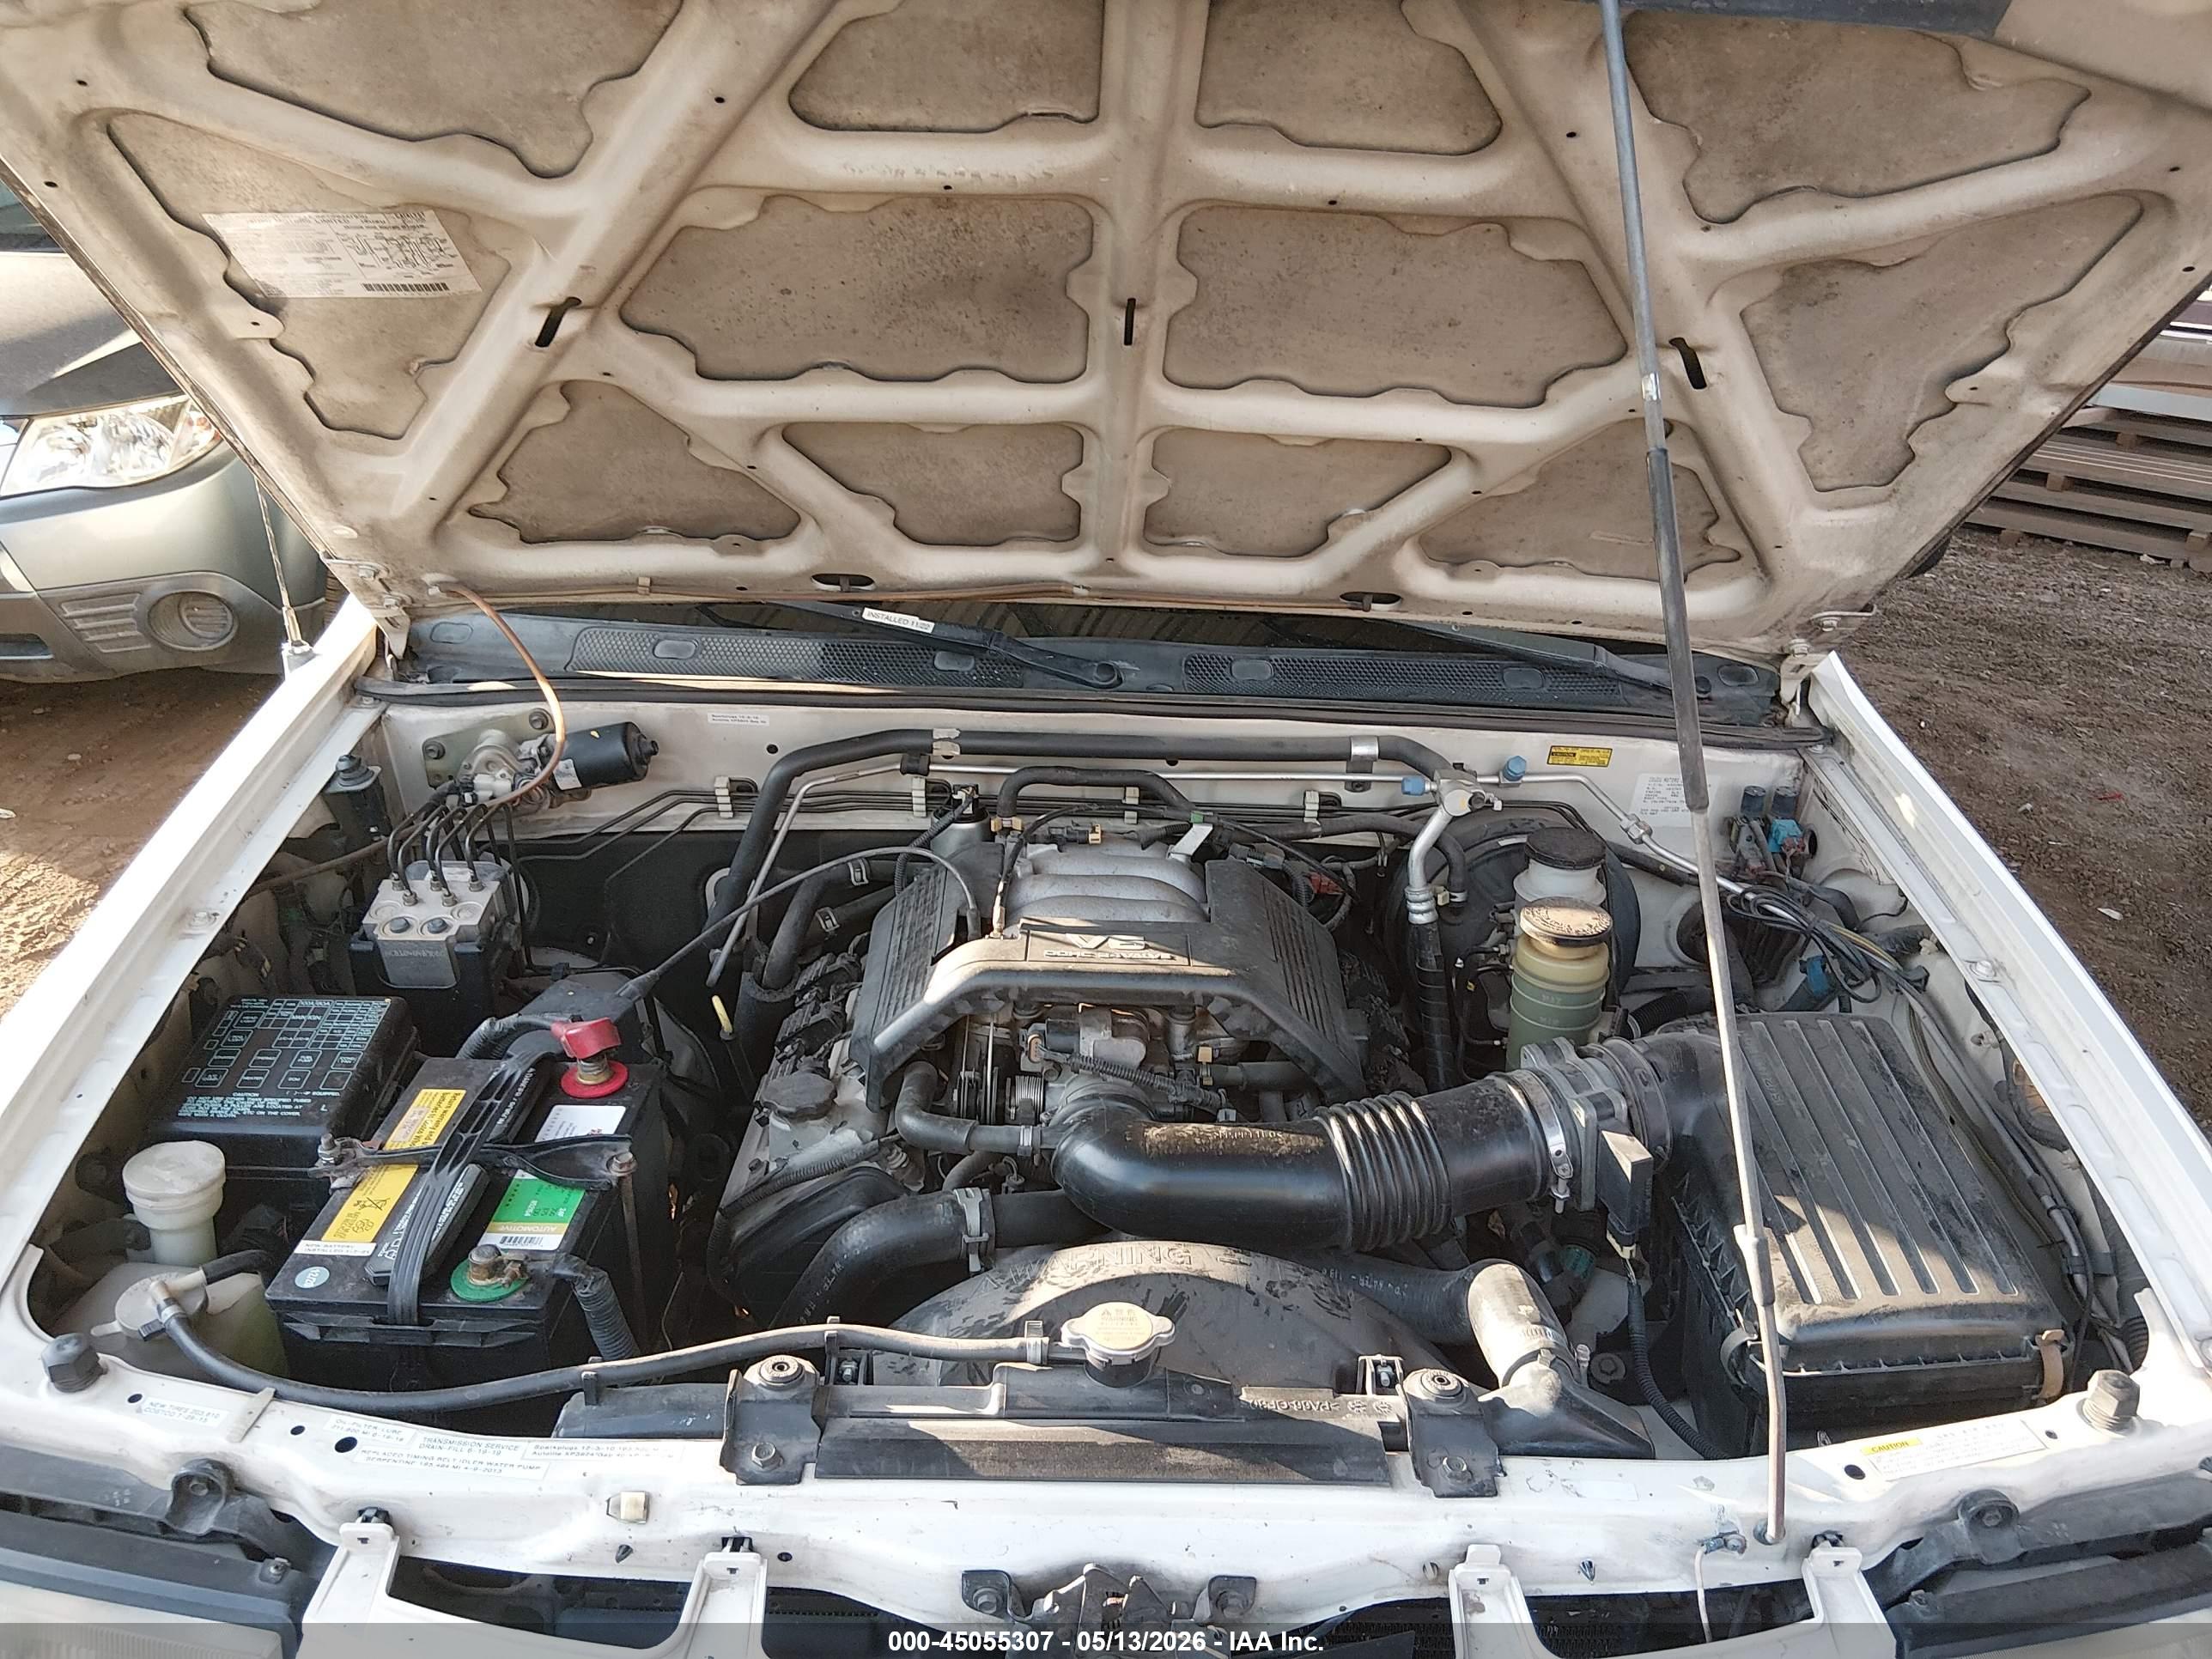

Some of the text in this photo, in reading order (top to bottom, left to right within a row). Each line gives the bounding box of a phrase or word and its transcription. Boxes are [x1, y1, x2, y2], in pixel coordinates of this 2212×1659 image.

[866, 610, 909, 626] INSTALLED
[1065, 933, 1146, 951] V6
[143, 1407, 177, 1417] COSTCO
[169, 1404, 191, 1413] TIRES
[418, 1443, 465, 1453] DRAIN-FILL
[422, 1437, 520, 1451] TRANSMISSION SERVICE
[1870, 1440, 1910, 1454] CAUTION
[361, 1449, 404, 1458] REPLACED
[406, 1453, 435, 1462] TIMING
[365, 1456, 416, 1466] SERPENTINE
